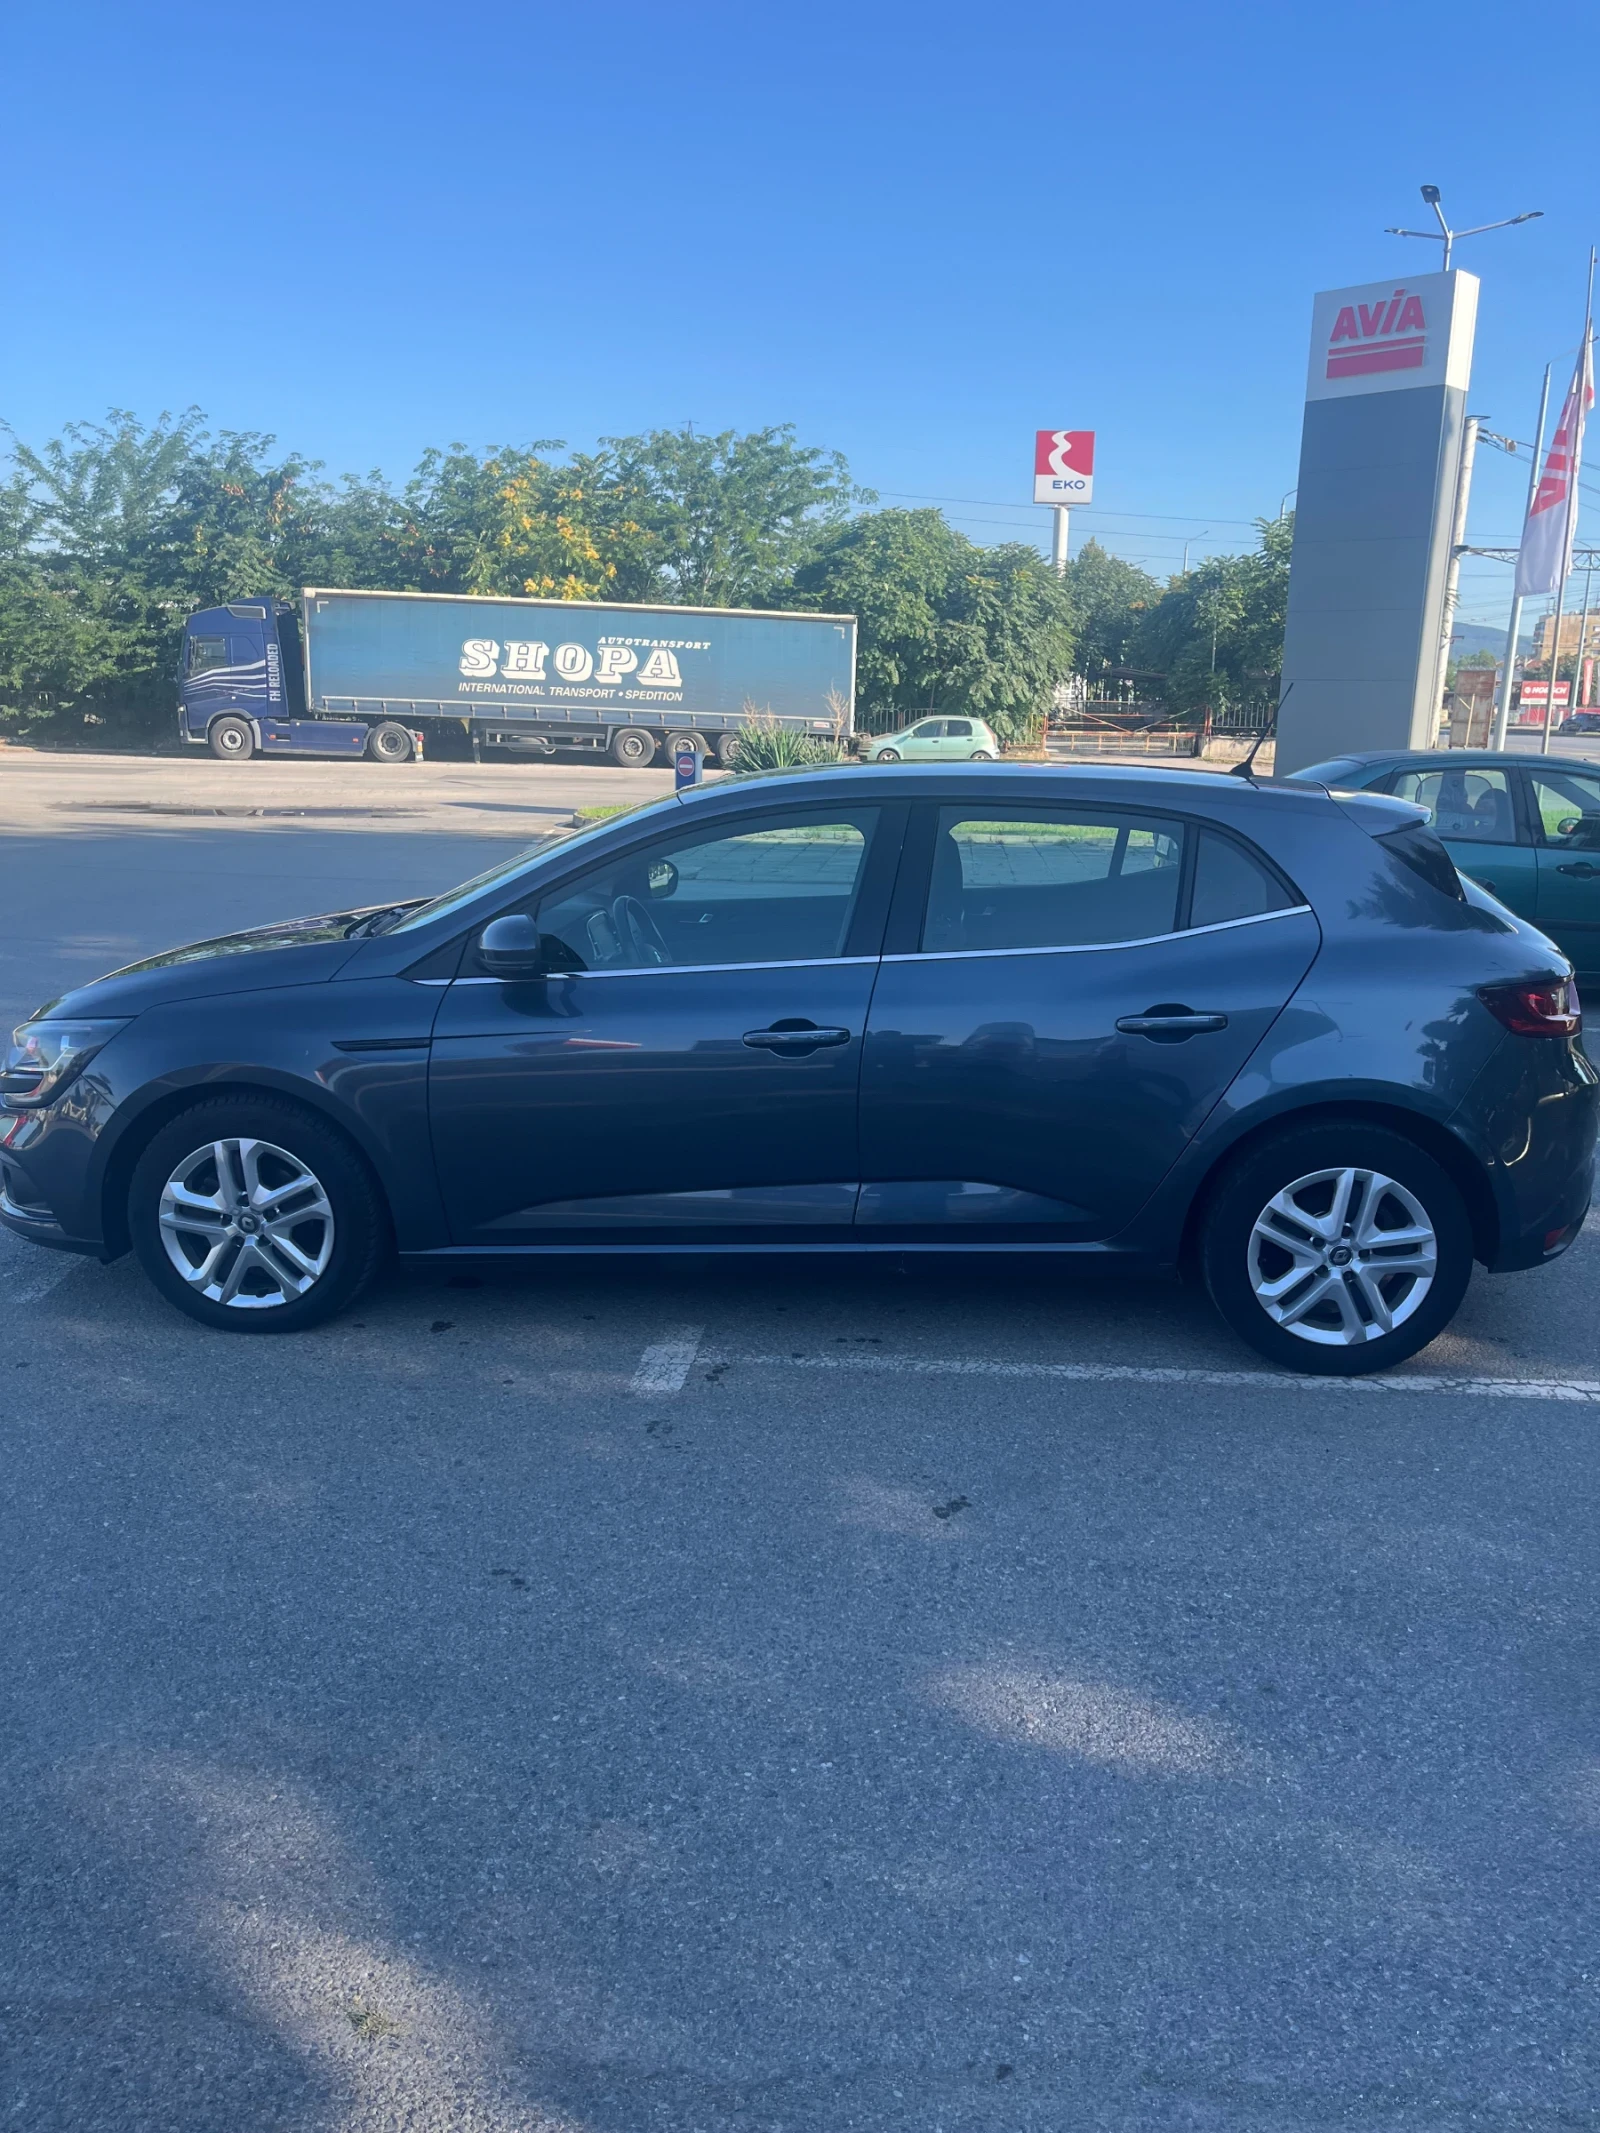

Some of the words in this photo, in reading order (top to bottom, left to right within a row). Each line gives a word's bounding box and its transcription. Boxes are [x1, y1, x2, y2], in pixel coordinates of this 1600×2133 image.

[1052, 480, 1085, 490] EKO
[597, 636, 711, 650] AUTOTRANSPORT
[267, 643, 281, 688] RELOADED
[459, 638, 683, 687] SHOPA
[269, 690, 281, 702] FH
[458, 682, 545, 696] INTERNATIONAL
[549, 686, 616, 699] TRANSPORT
[625, 690, 683, 702] SPEDITION
